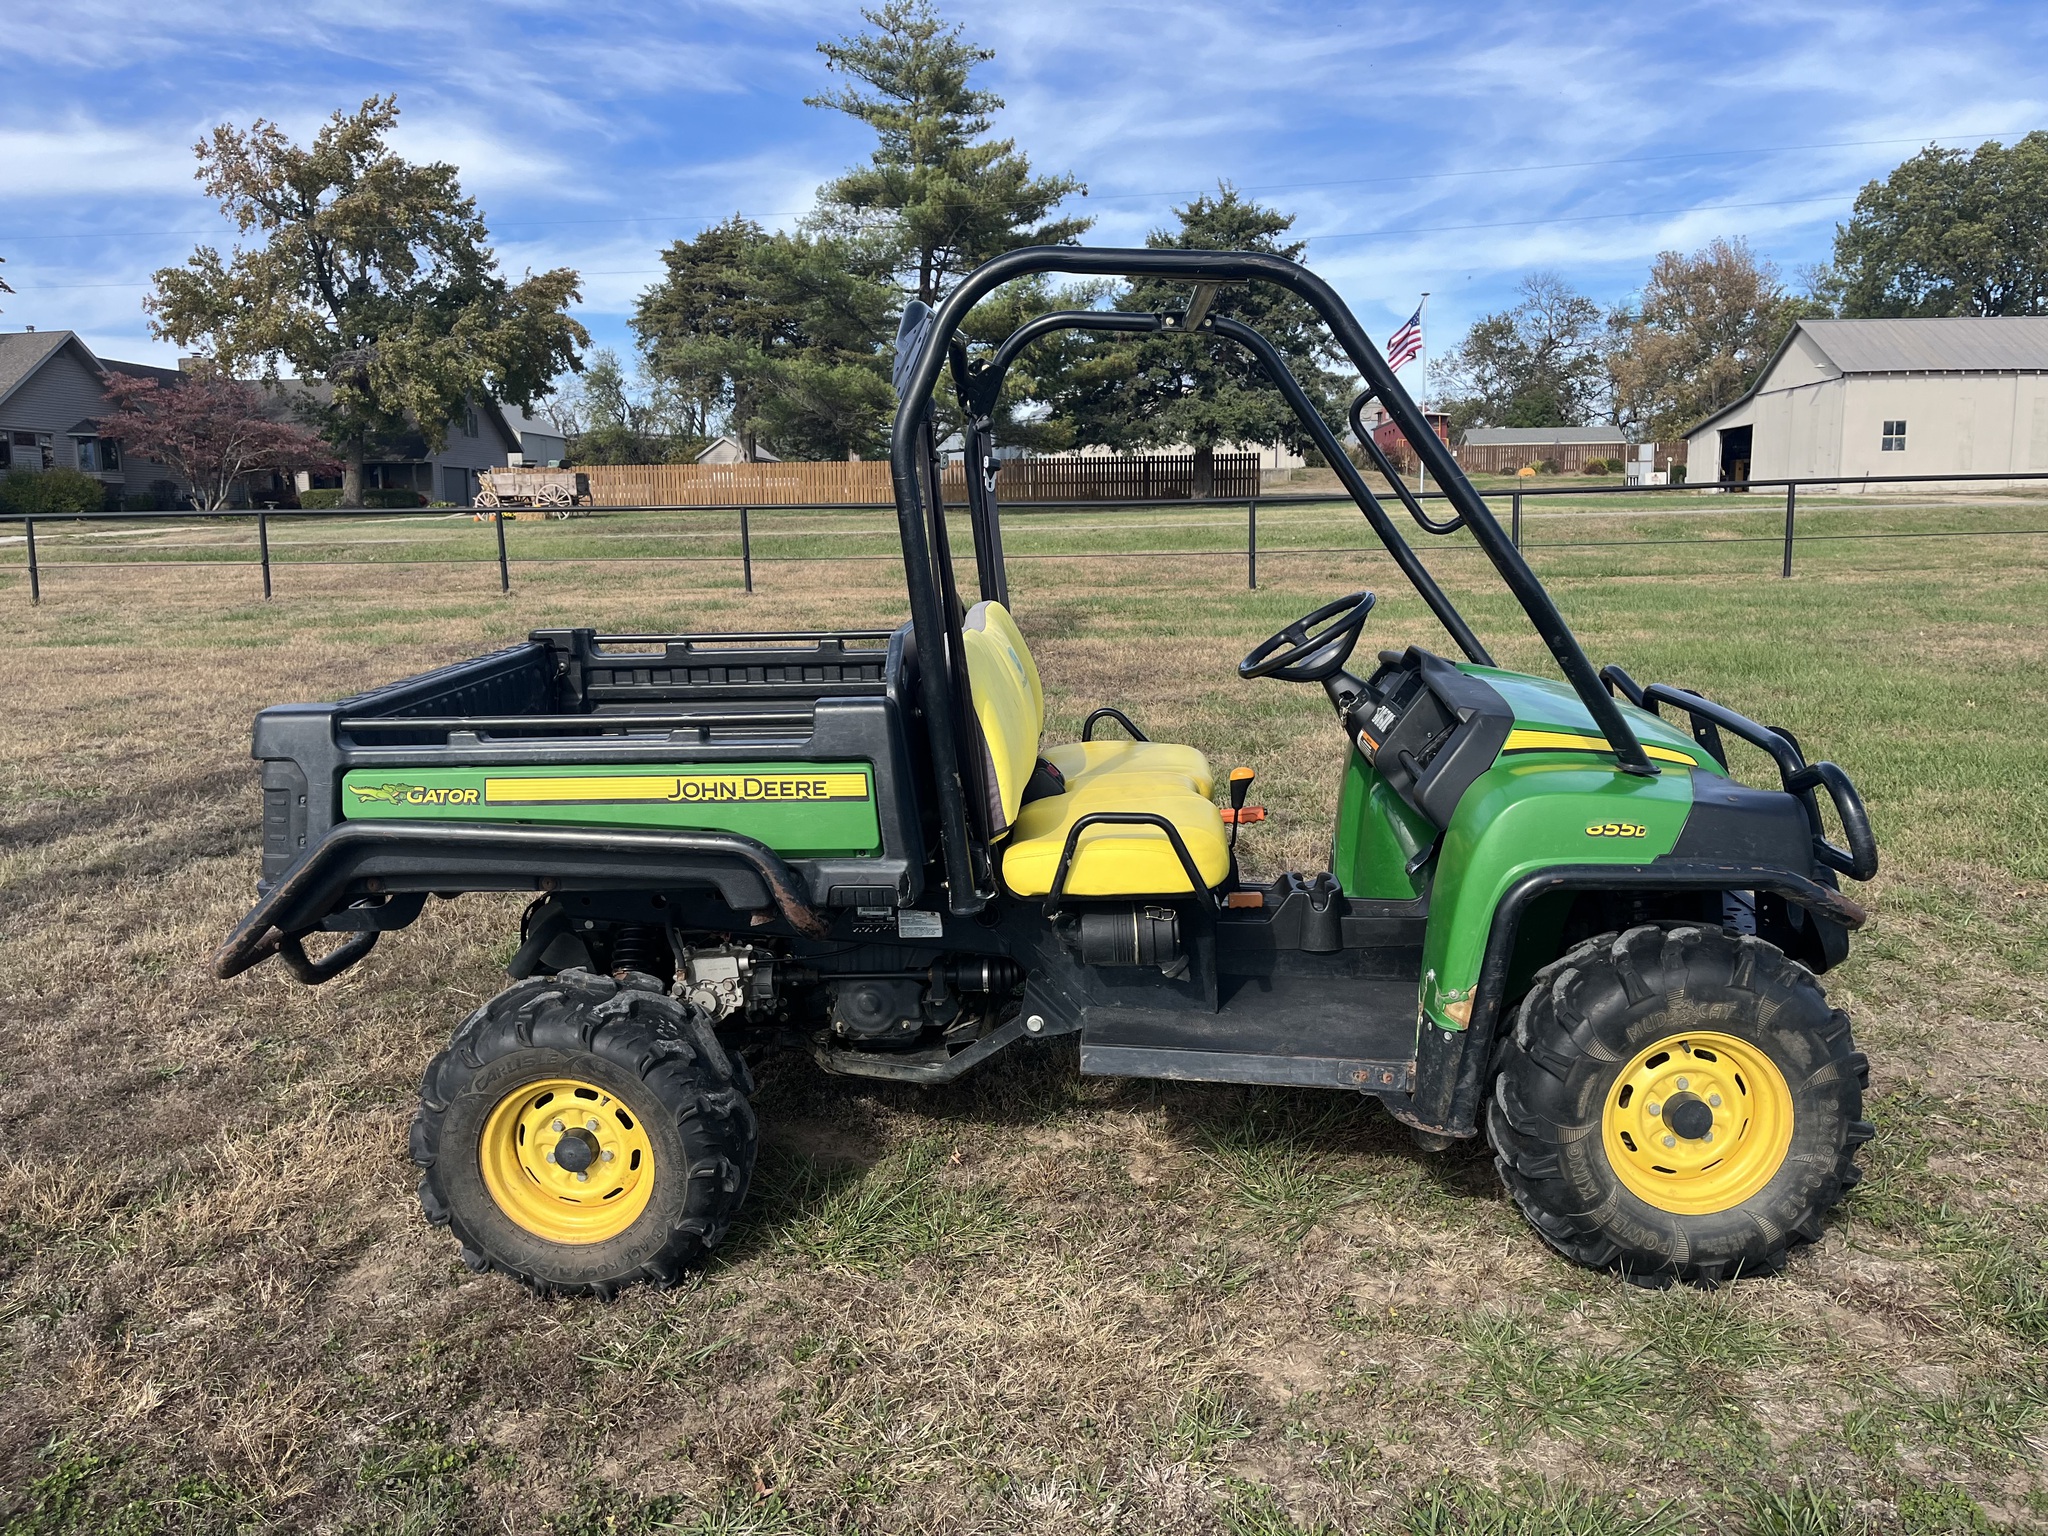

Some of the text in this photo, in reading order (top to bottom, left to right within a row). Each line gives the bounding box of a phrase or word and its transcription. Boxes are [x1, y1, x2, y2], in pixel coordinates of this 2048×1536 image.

[406, 785, 480, 805] GATOR
[667, 778, 829, 801] JOHN DEERE
[1625, 1000, 1738, 1043] MUD CAT
[475, 1052, 559, 1092] CARLISLE
[1566, 1141, 1673, 1256] POWER KING
[622, 1226, 664, 1263] BLACK
